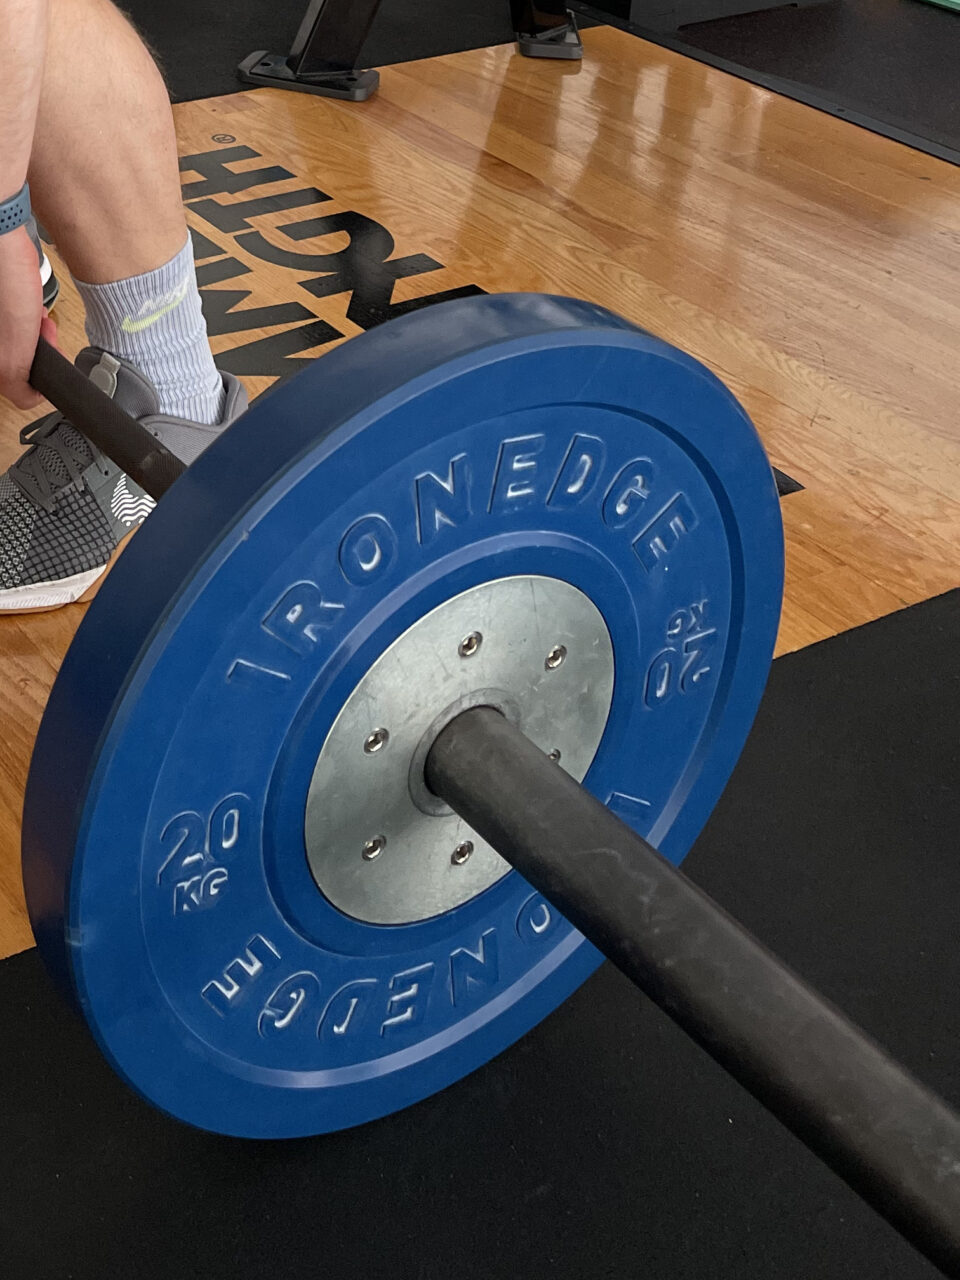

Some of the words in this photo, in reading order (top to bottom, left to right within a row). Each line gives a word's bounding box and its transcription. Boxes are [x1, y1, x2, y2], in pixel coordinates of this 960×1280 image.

[227, 433, 696, 683] IRONEDGE
[667, 597, 711, 647] KG
[643, 624, 717, 710] 20
[156, 791, 251, 889] 20
[171, 866, 232, 917] KG
